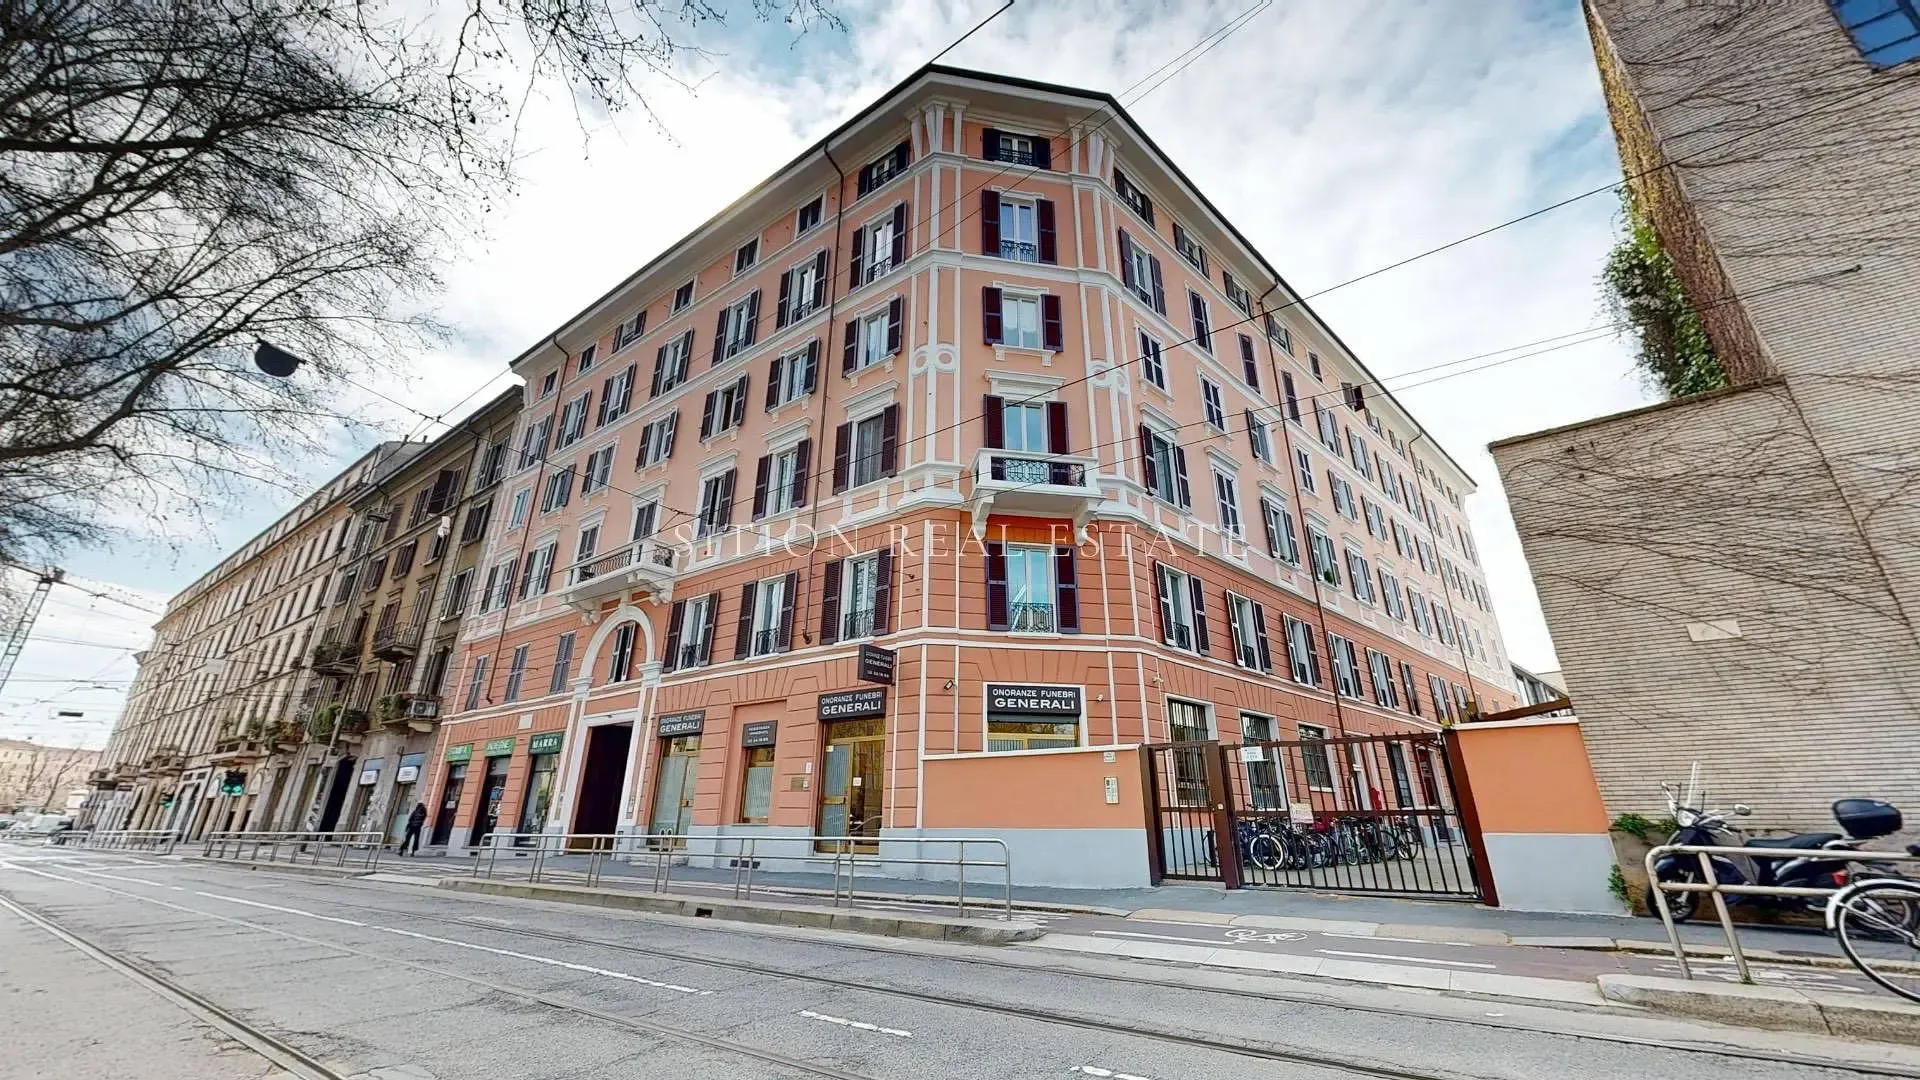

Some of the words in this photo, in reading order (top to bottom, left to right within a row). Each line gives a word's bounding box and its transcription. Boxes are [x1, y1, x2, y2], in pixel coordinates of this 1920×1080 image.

[821, 694, 853, 705] ONORANZE
[855, 691, 882, 700] FUNEBRI
[992, 688, 1037, 697] ONORANZE
[1040, 690, 1076, 698] FUNEBRI
[822, 700, 881, 715] GENERALI
[994, 698, 1075, 710] GENERALI
[660, 721, 700, 733] GENERALI
